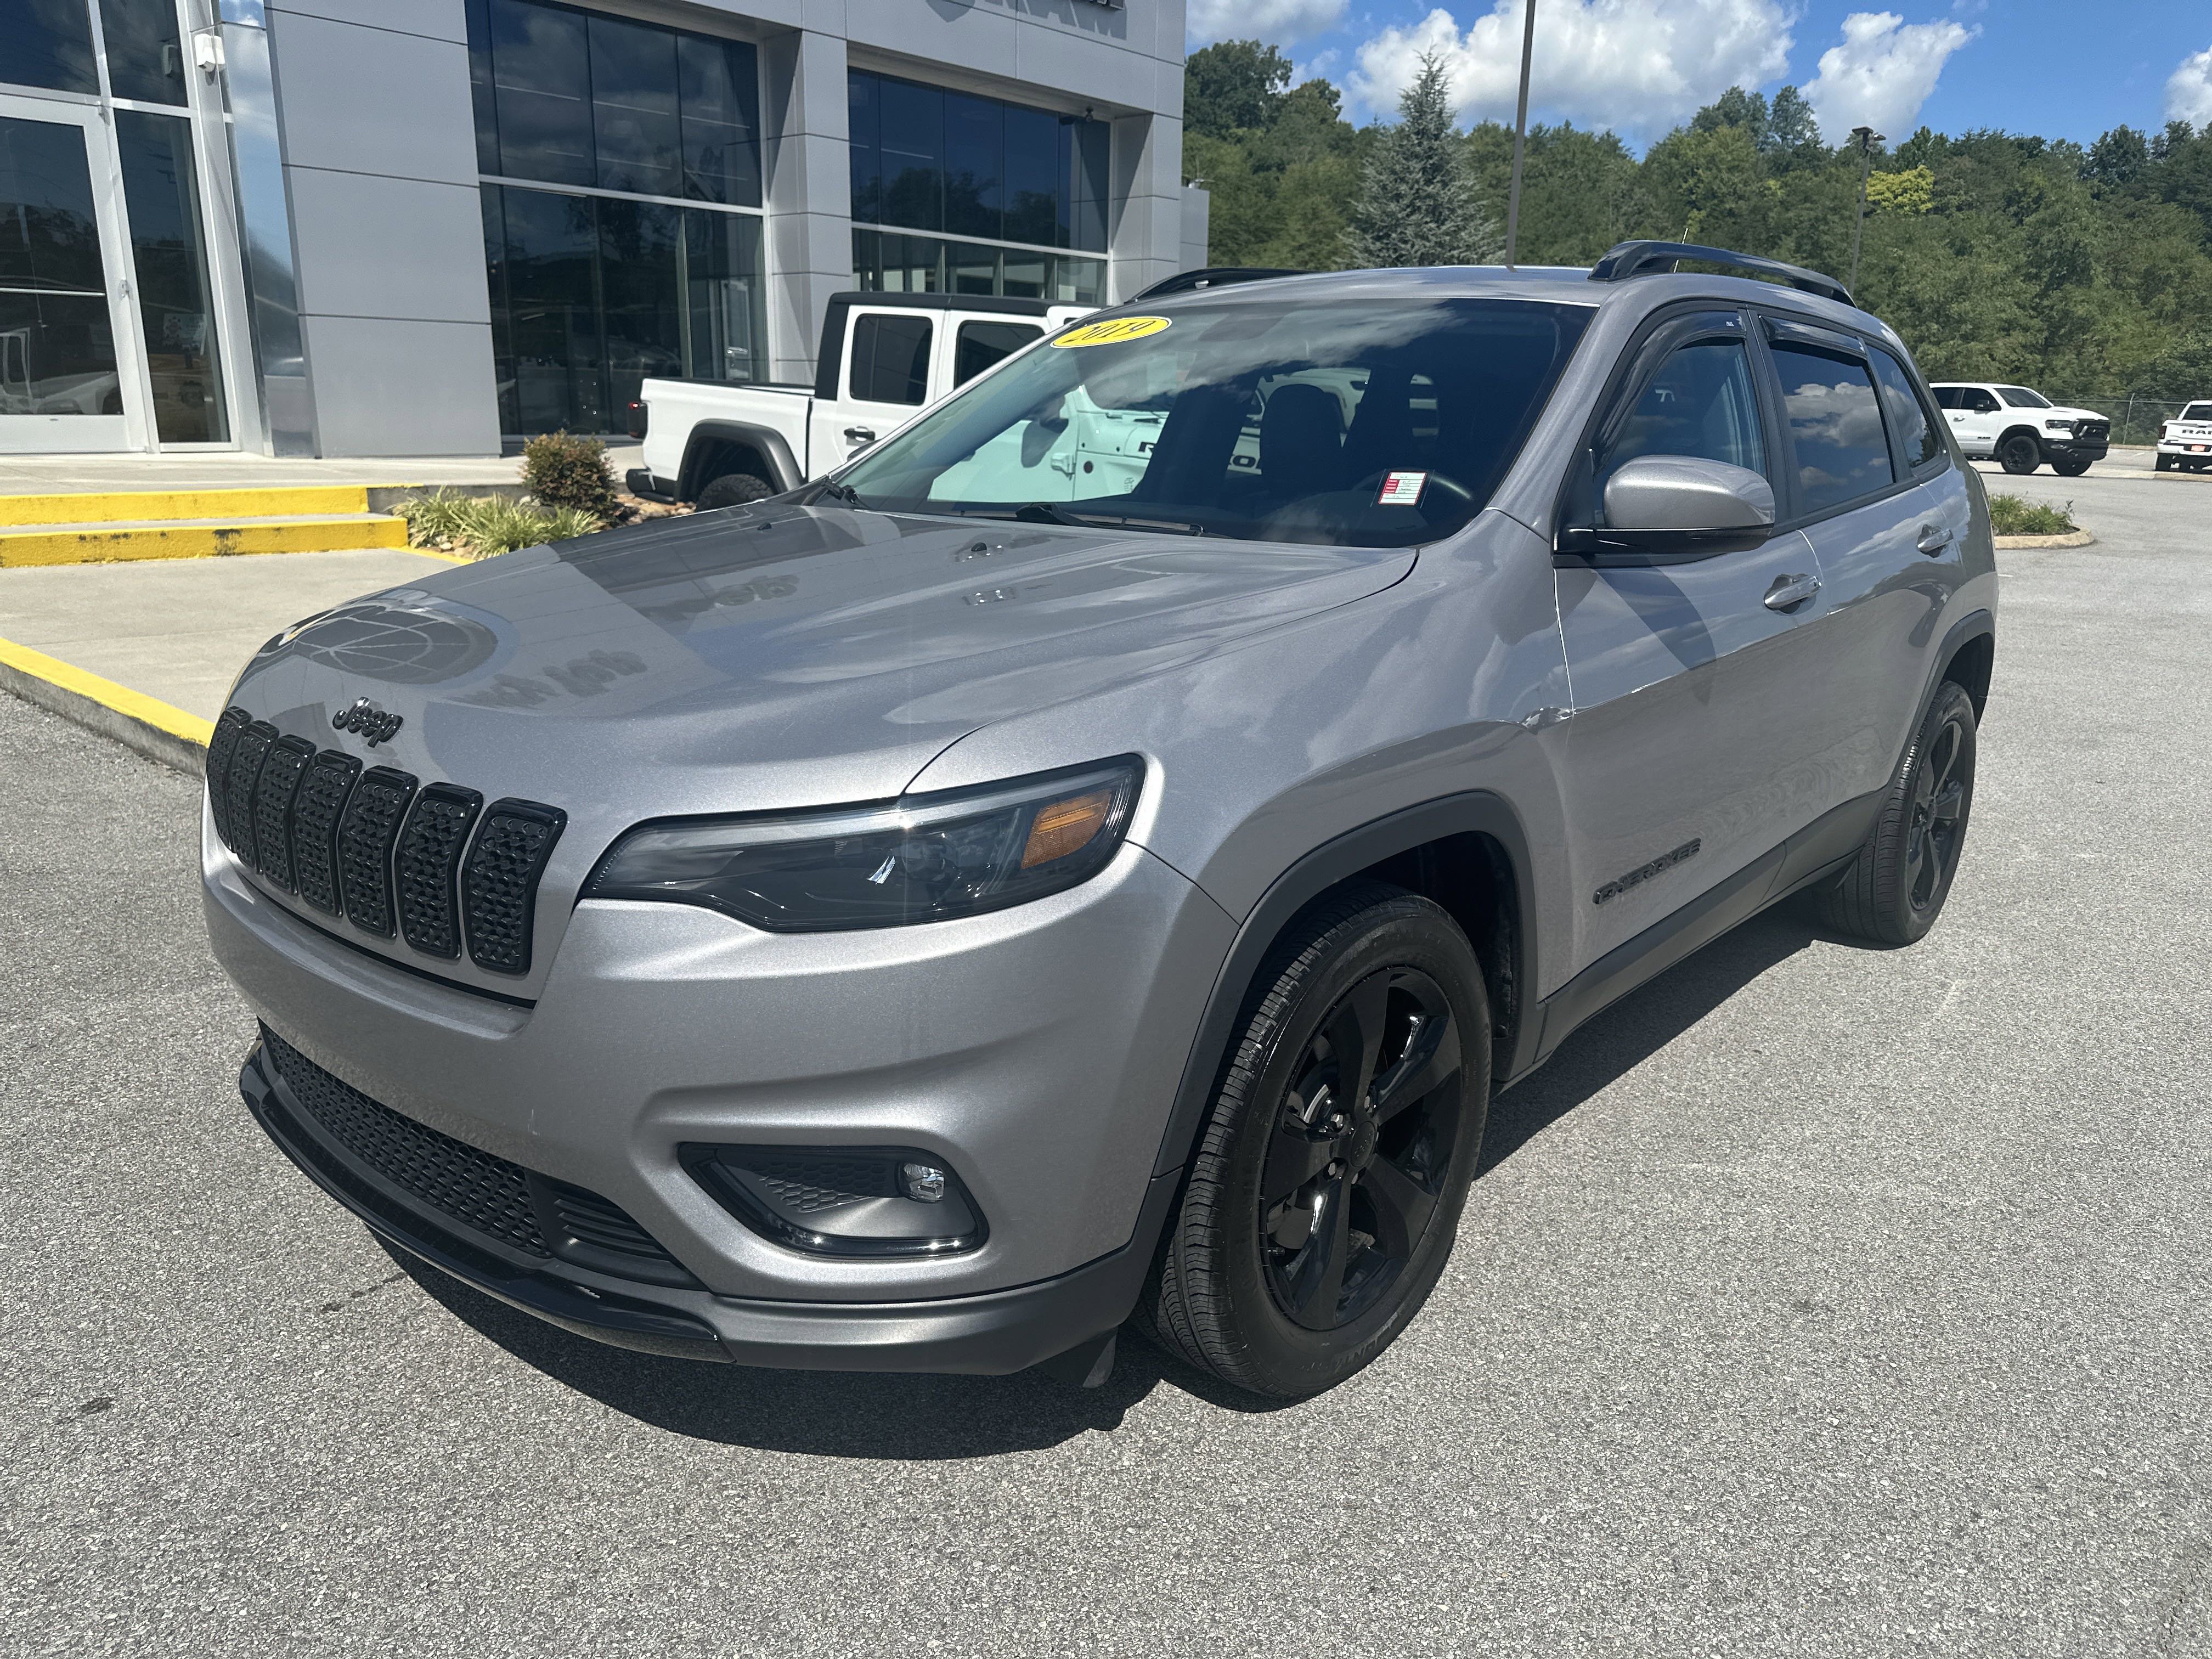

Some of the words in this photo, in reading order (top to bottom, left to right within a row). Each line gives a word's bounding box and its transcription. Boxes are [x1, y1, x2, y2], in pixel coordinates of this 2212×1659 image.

[1061, 320, 1157, 344] 2019
[332, 696, 404, 748] Jeep
[1592, 838, 1701, 905] CHEROKEE
